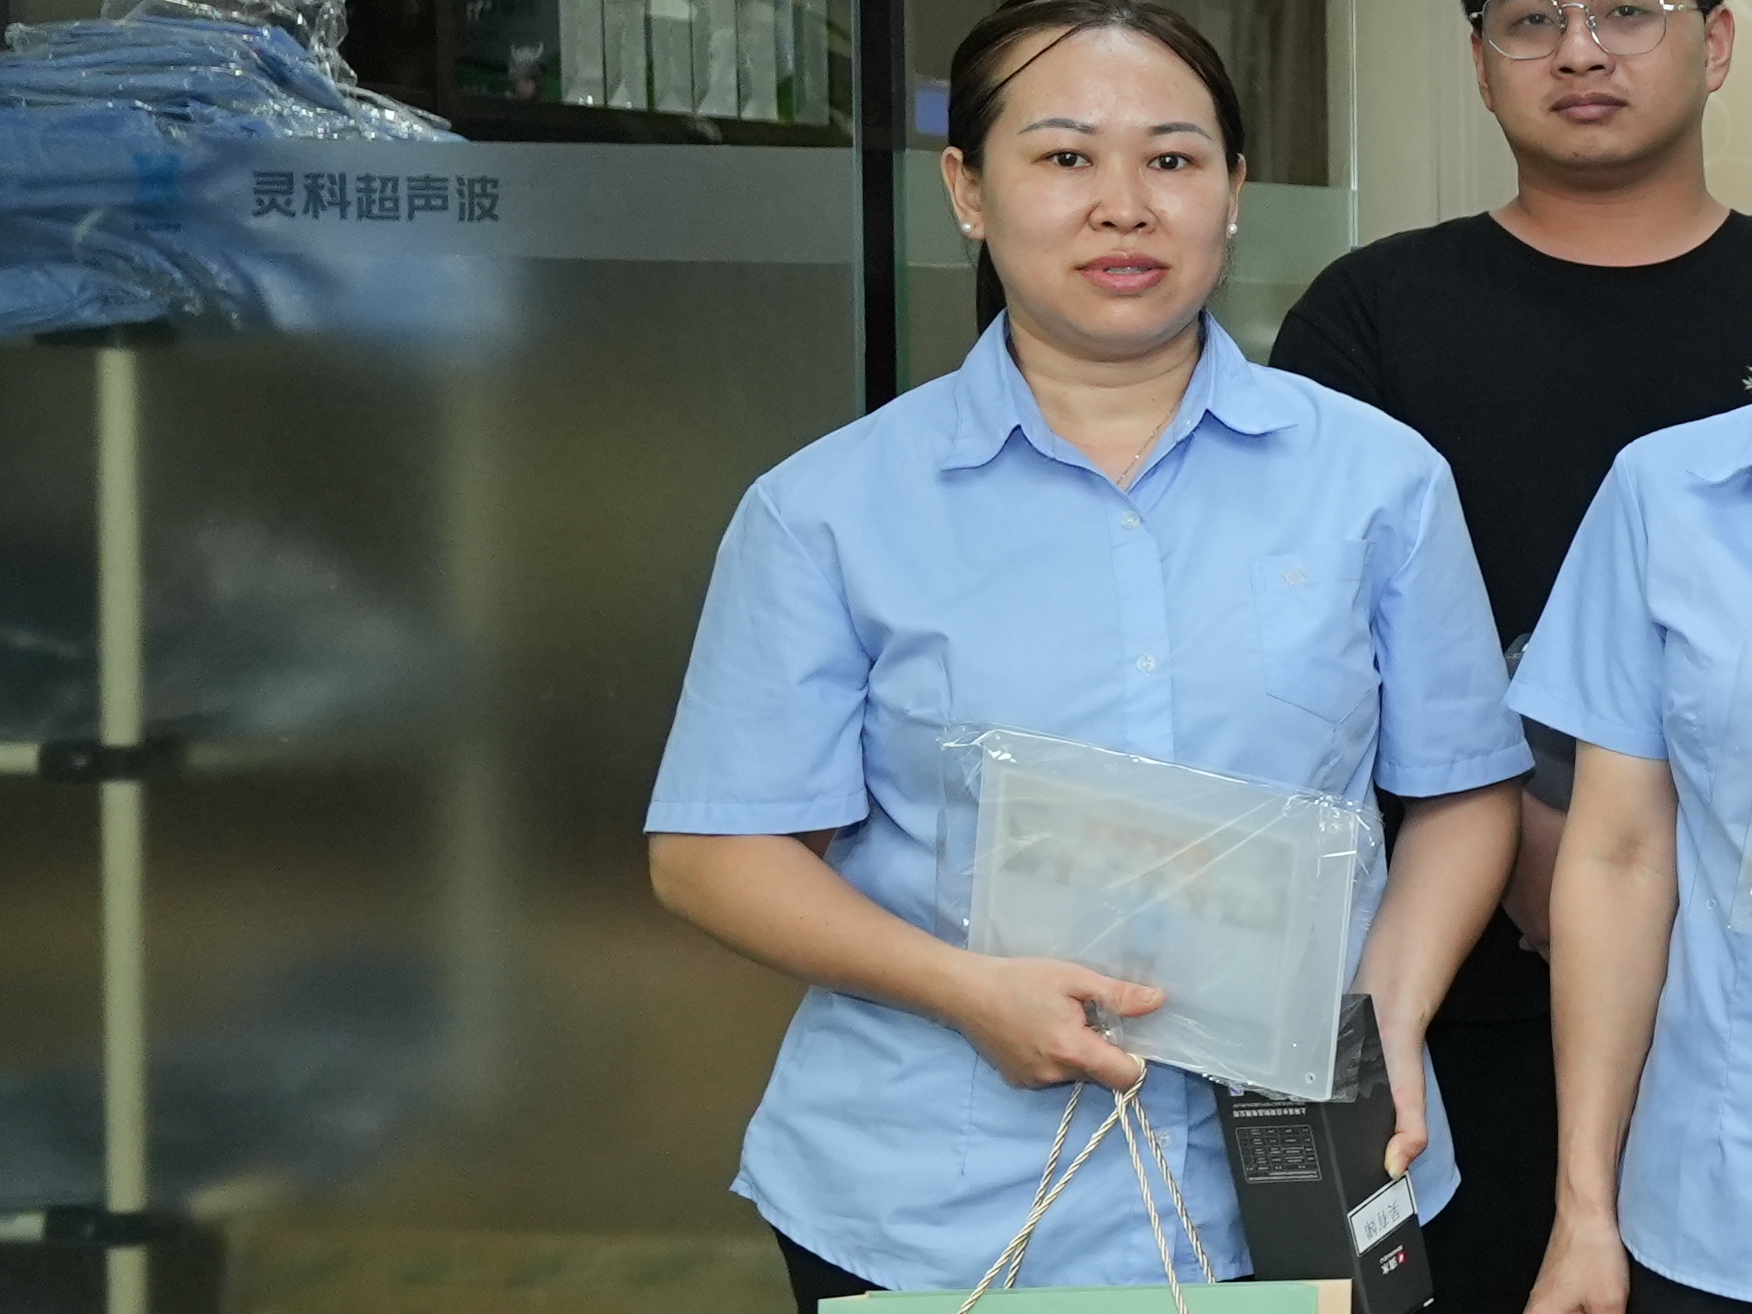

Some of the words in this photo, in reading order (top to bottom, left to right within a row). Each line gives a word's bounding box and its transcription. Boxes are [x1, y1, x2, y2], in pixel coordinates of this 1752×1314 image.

[251, 171, 500, 223] 灵科超声波
